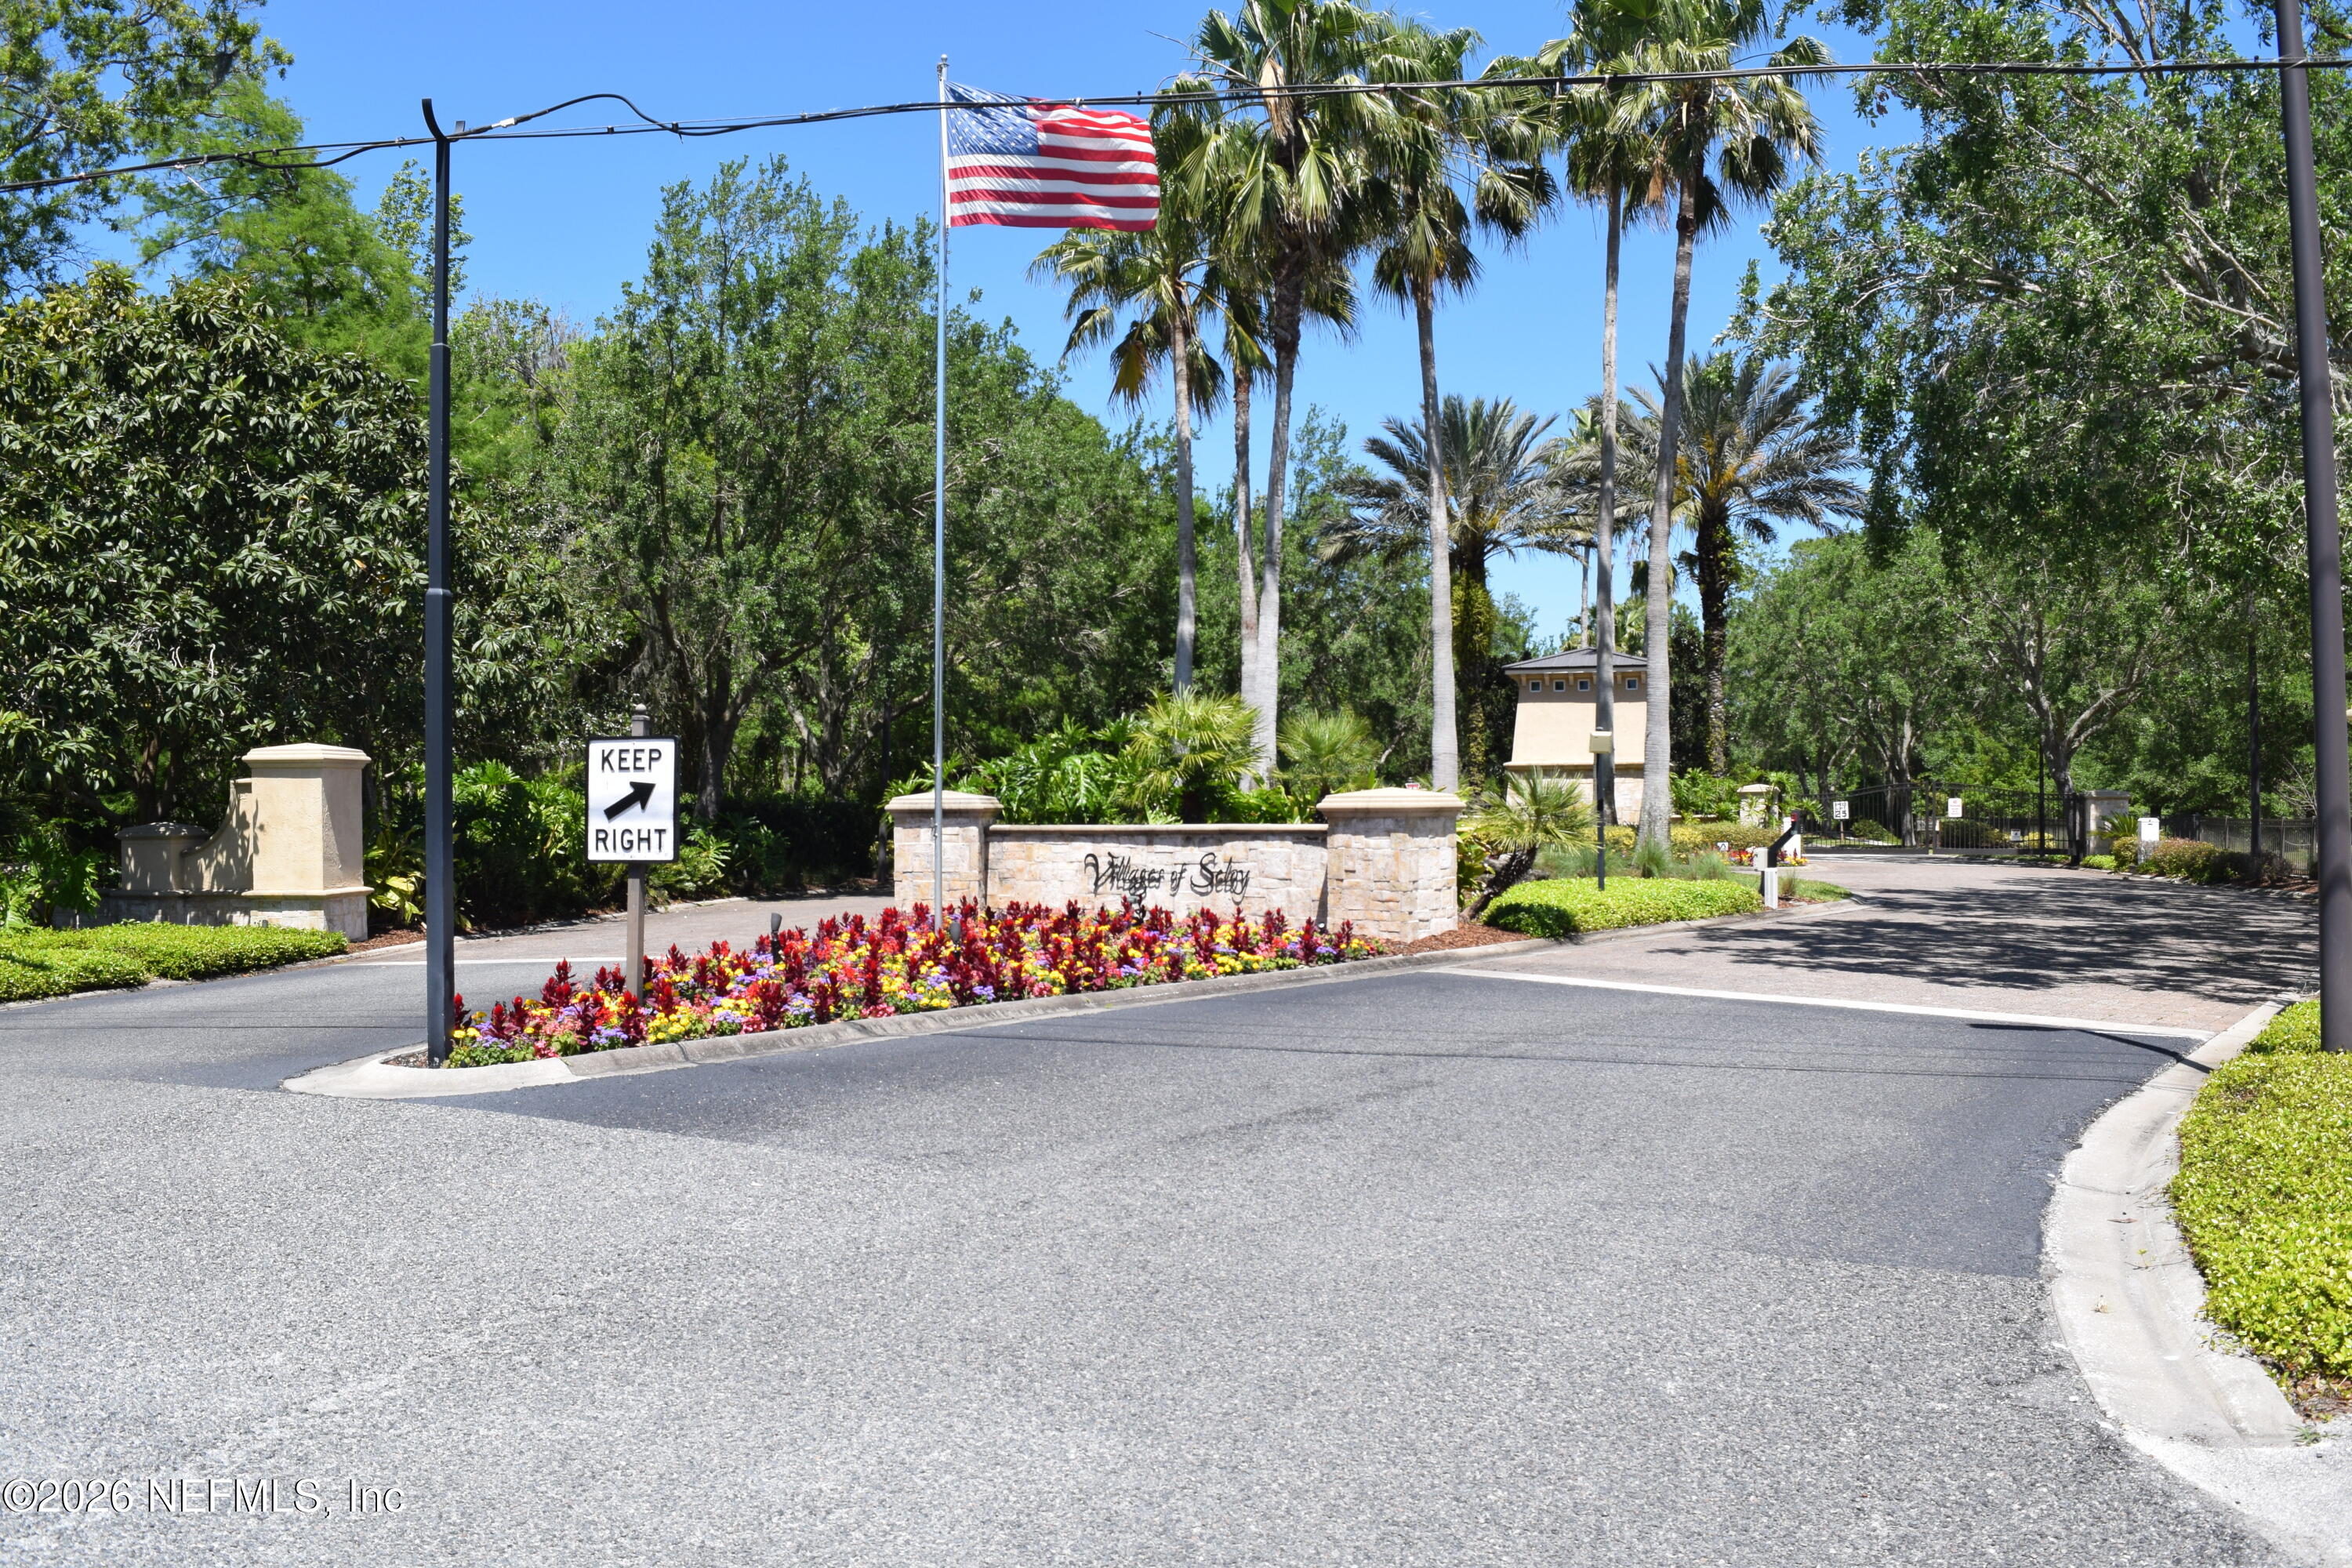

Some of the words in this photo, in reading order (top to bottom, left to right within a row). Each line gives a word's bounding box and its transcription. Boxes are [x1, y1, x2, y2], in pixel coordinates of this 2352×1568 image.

[601, 749, 662, 771] KEEP
[595, 829, 666, 852] RIGHT
[1083, 851, 1165, 897] Villages
[1170, 863, 1186, 895] of
[1190, 852, 1250, 898] Selby
